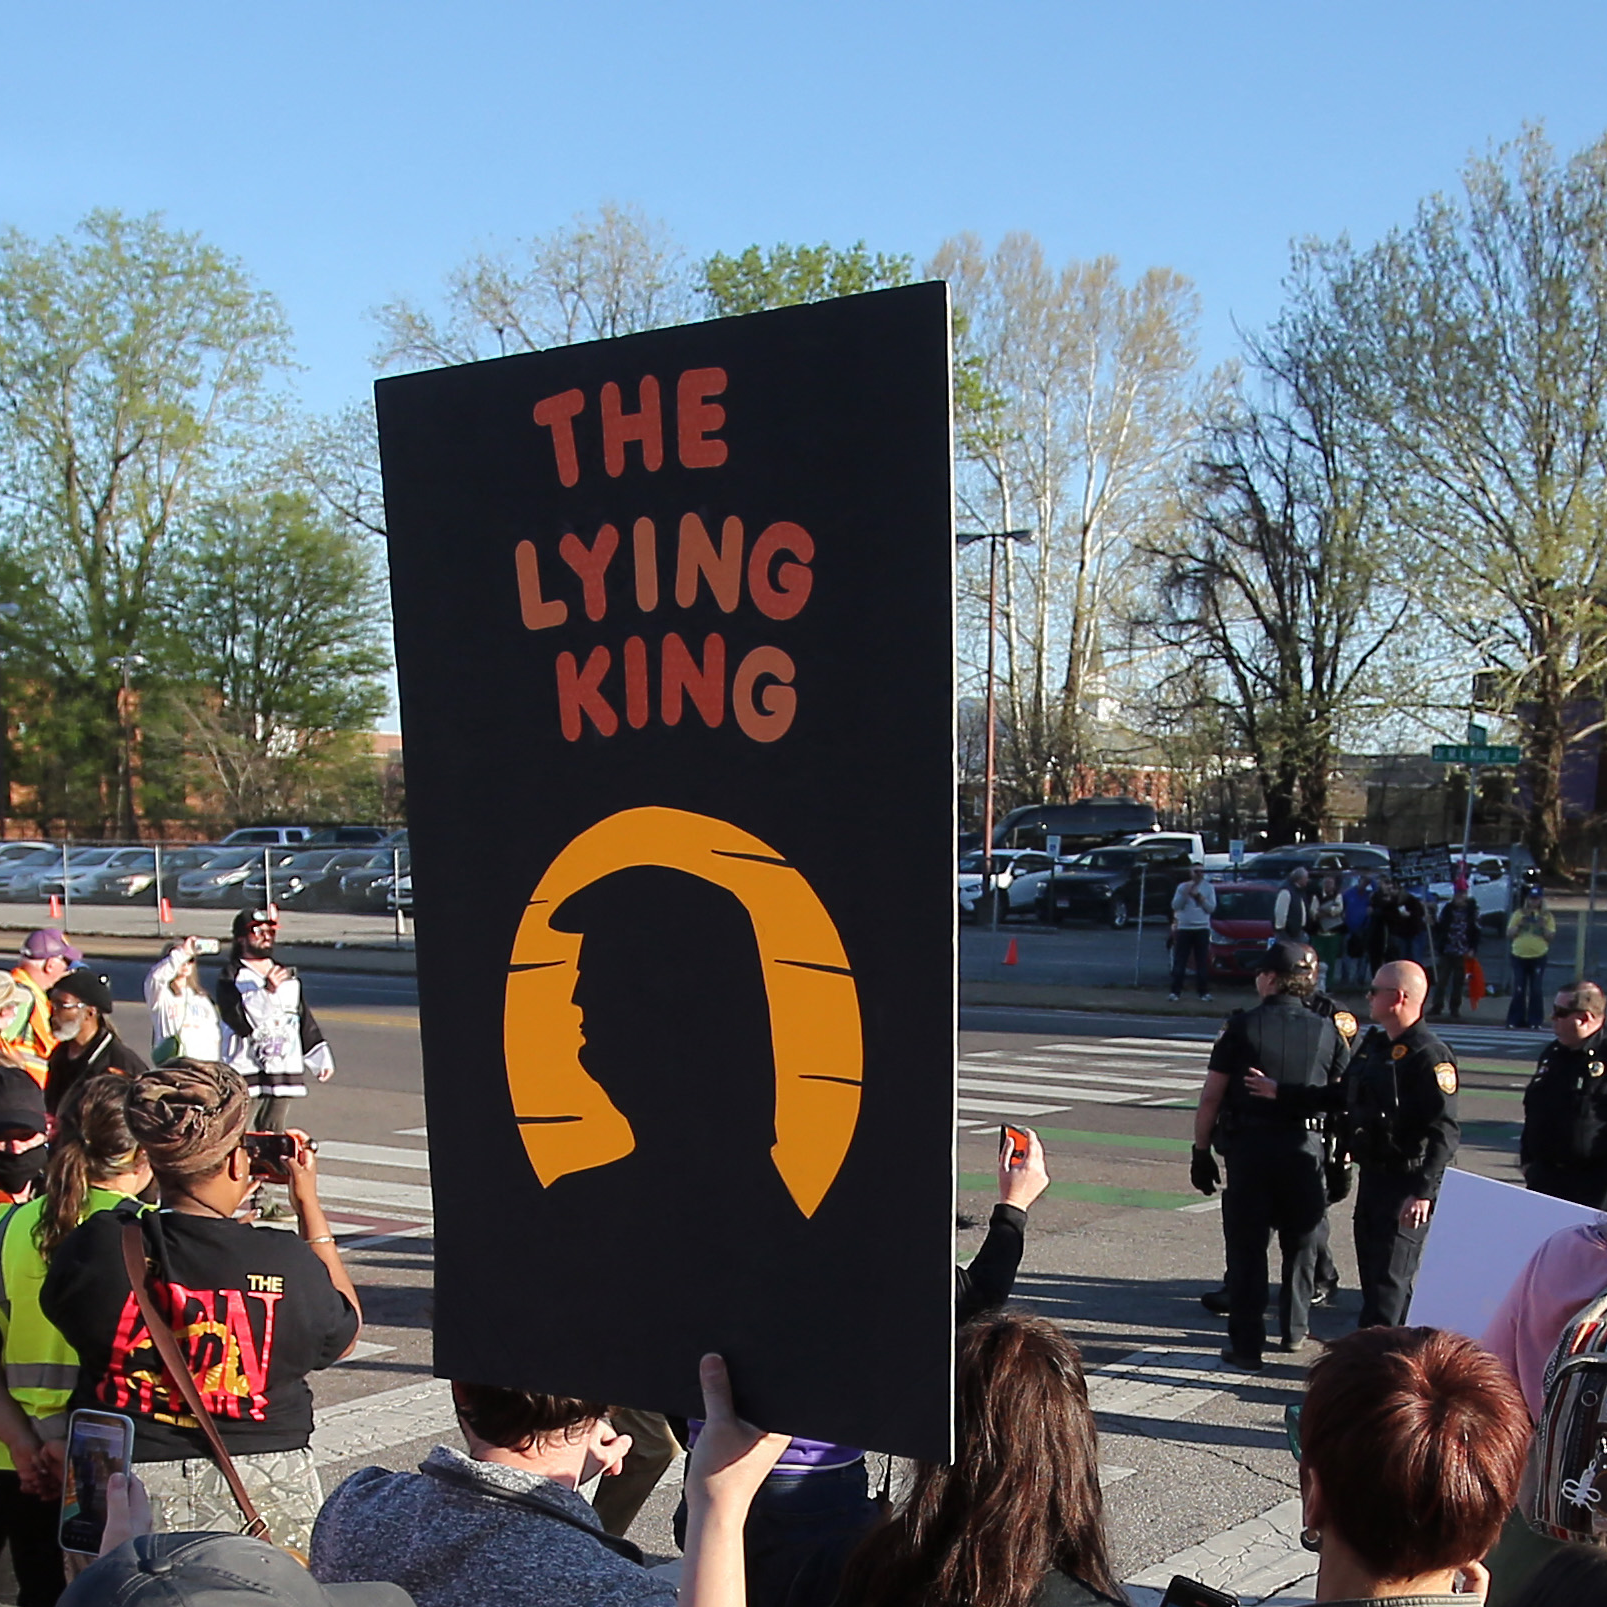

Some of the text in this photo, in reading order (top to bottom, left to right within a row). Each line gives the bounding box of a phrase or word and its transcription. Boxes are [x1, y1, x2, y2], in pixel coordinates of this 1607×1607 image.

[533, 367, 728, 487] THE
[515, 512, 815, 630] LYING
[556, 632, 797, 742] KING
[246, 1273, 284, 1293] THE
